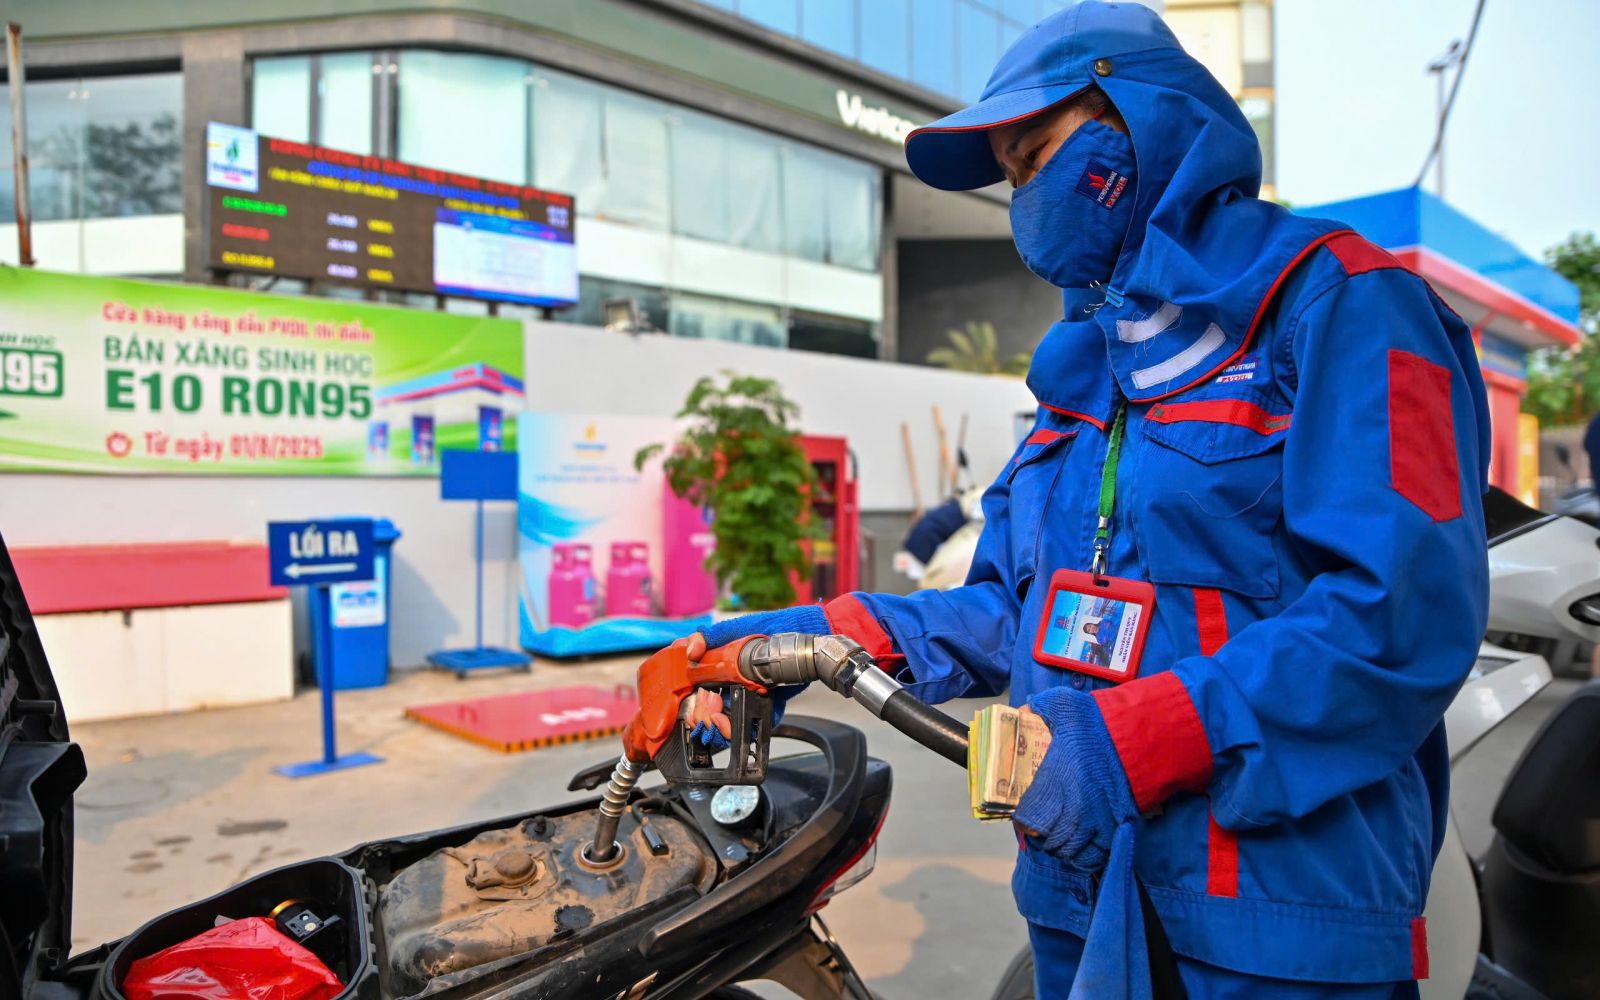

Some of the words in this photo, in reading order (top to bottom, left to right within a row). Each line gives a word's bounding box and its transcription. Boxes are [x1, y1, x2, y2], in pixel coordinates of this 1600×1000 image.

[143, 304, 185, 332] hàng
[104, 332, 164, 362] BÁN
[176, 337, 248, 369] XĂNG
[257, 346, 316, 373] SINH
[0, 351, 58, 394] 95
[105, 368, 202, 413] E10
[222, 376, 372, 419] RON95
[144, 430, 168, 455] Từ
[175, 432, 224, 463] ngày
[290, 524, 324, 558] LỐI
[328, 531, 359, 557] RA
